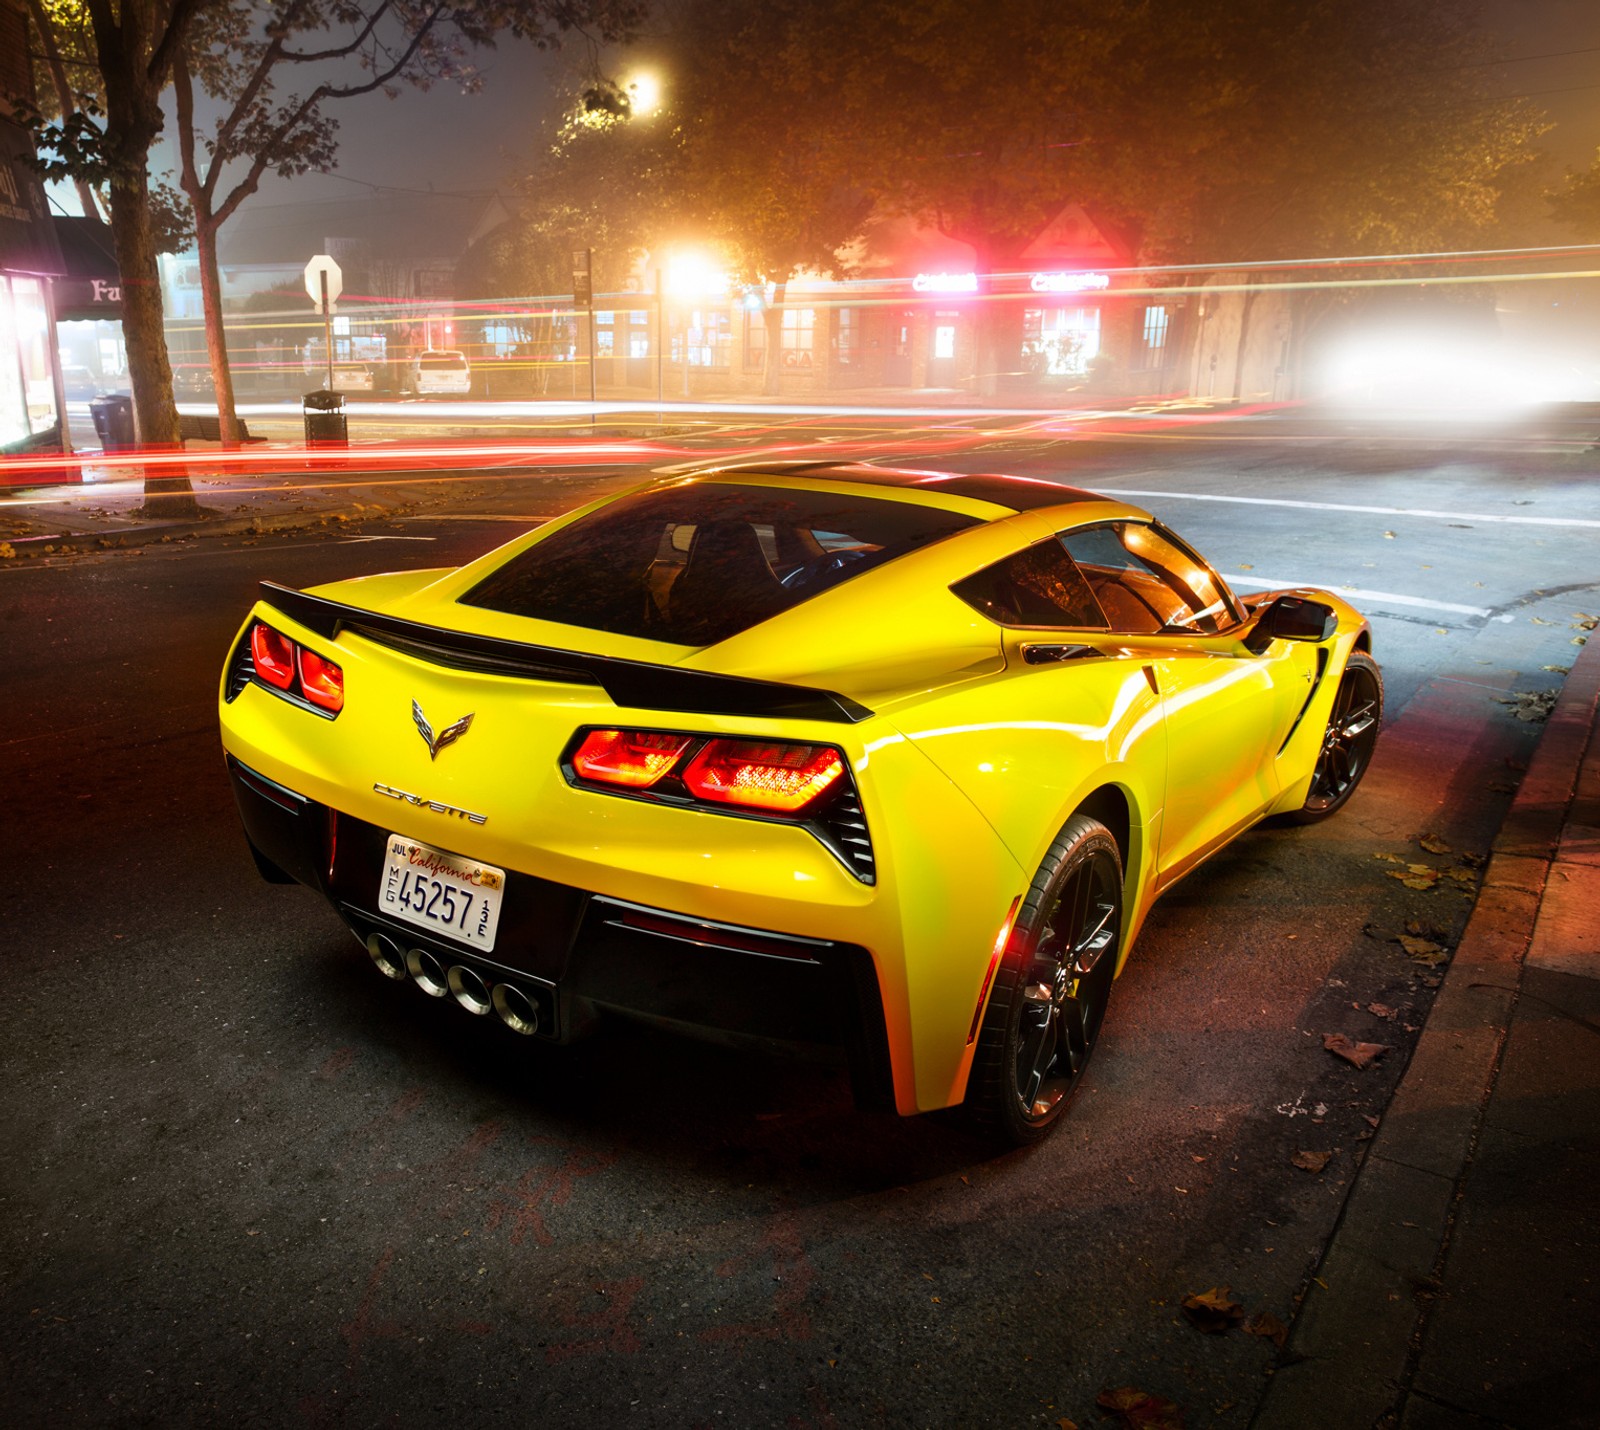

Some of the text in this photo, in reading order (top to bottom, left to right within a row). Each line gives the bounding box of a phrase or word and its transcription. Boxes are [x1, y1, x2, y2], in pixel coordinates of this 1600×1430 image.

[373, 782, 488, 825] CORVETTE
[385, 865, 399, 903] MFG
[391, 843, 407, 857] JUL
[408, 847, 482, 887] California
[398, 869, 474, 930] 45257
[477, 899, 491, 937] 13E
